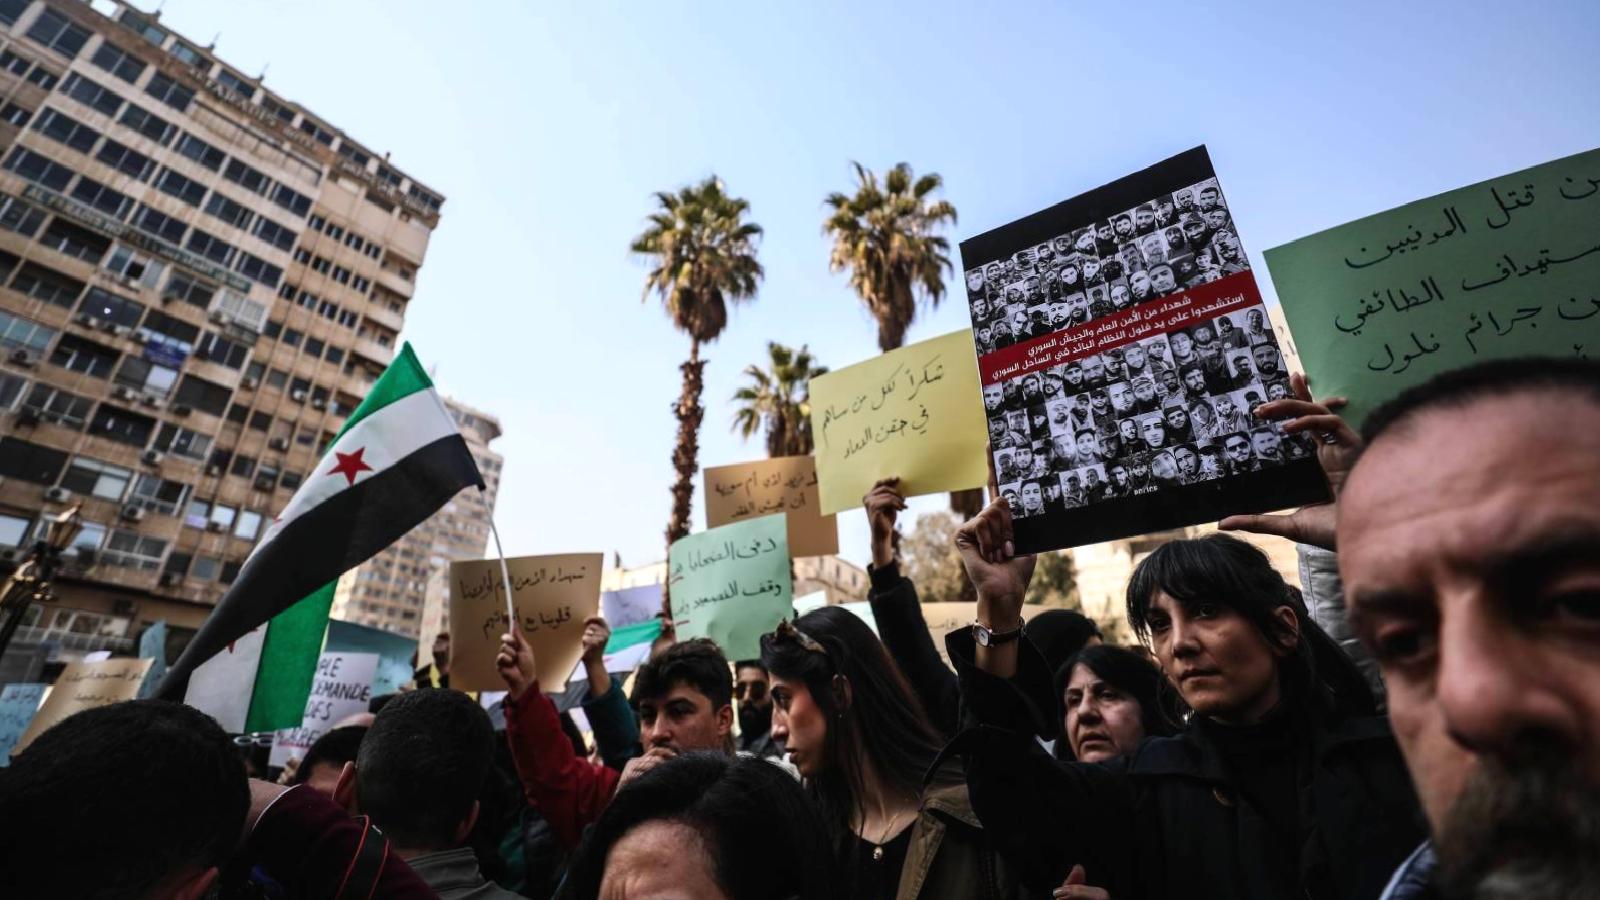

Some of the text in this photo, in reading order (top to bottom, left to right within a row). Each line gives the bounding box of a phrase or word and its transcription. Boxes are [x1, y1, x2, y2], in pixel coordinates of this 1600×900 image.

[1486, 184, 1536, 230] قتل
[1344, 206, 1467, 269] المدنيين
[1334, 276, 1445, 336] الطائفي
[992, 293, 1245, 380] استشهدوا على يد فلول النظام البائد في الساحل السوري
[1027, 295, 1191, 357] شهداء من الأمن العام والجيش السوري
[1464, 306, 1543, 354] جرائم
[1367, 332, 1441, 374] فلول
[852, 395, 867, 414] من
[911, 404, 930, 435] في
[822, 404, 849, 450] ساهم
[875, 418, 908, 444] حقن
[688, 540, 736, 571] الضحايا
[549, 565, 587, 583] شهداء
[742, 580, 782, 597] وقف
[539, 606, 572, 630] قلوبنا
[320, 657, 343, 678] PLE
